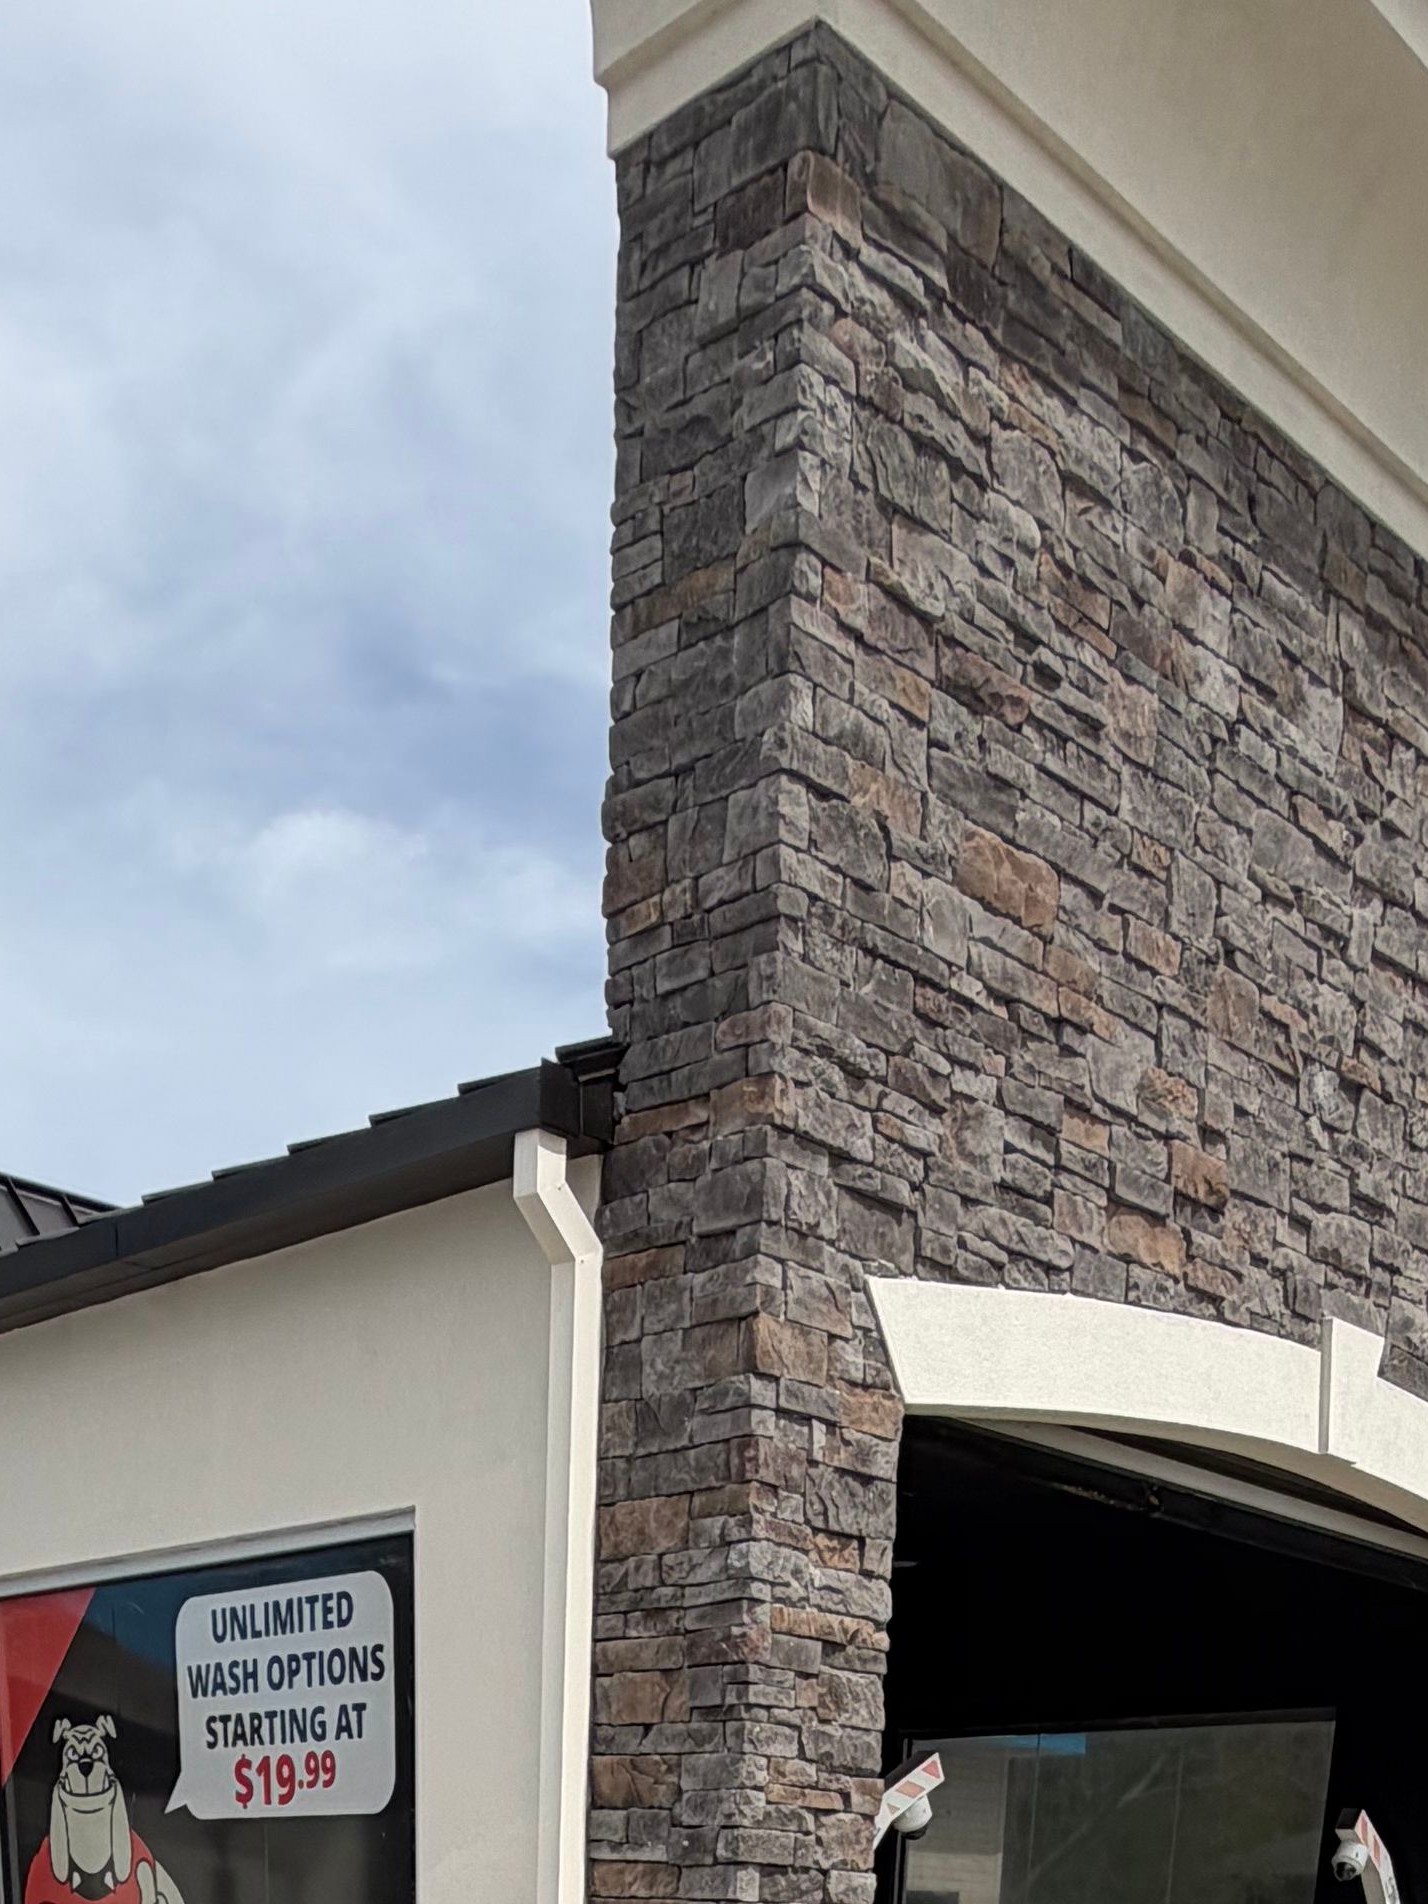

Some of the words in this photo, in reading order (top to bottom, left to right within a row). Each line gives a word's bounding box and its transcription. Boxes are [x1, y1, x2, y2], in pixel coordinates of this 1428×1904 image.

[211, 1590, 354, 1643] UNLIMITED
[187, 1658, 259, 1699] WASH
[266, 1643, 385, 1691] OPTIONS
[205, 1706, 327, 1749] STARTING
[335, 1702, 367, 1741] AT
[234, 1749, 336, 1809] $19.99
